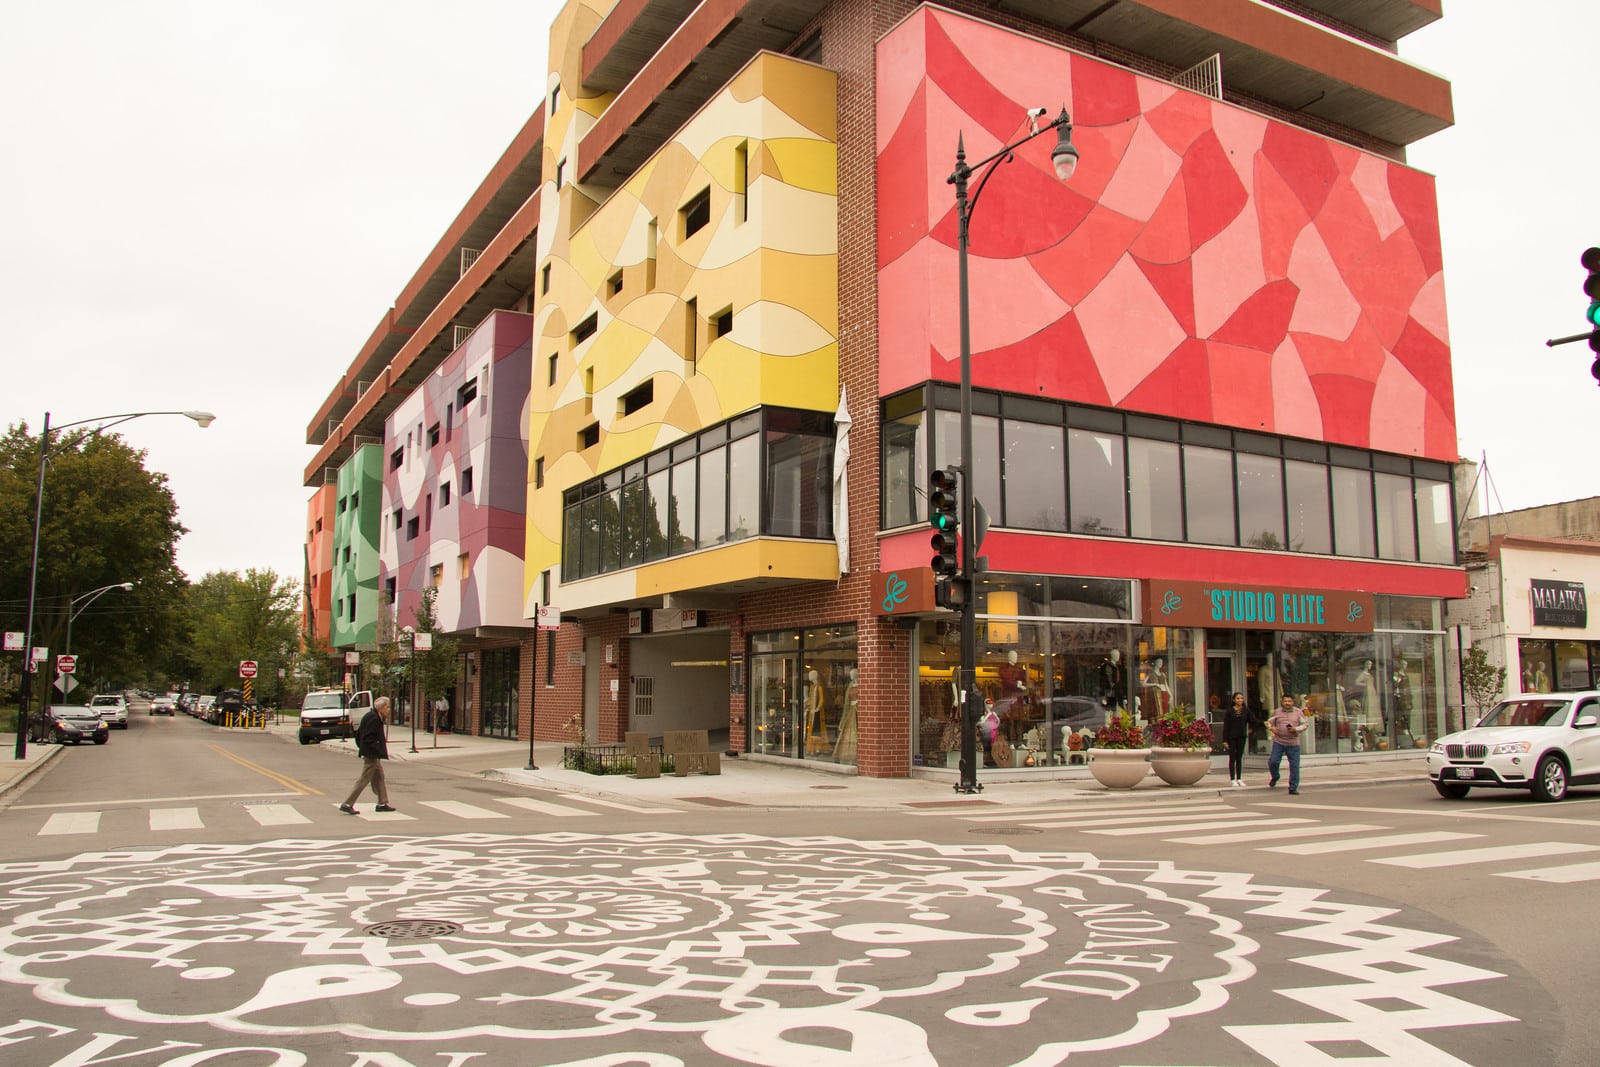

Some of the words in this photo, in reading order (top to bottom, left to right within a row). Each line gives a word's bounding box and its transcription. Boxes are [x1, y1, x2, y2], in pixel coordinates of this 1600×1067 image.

[1211, 589, 1275, 623] STUDIO
[1283, 593, 1325, 625] ELITE
[1532, 587, 1585, 611] MALAIKA
[630, 617, 640, 628] EXIT
[1020, 903, 1179, 1000] DEVON
